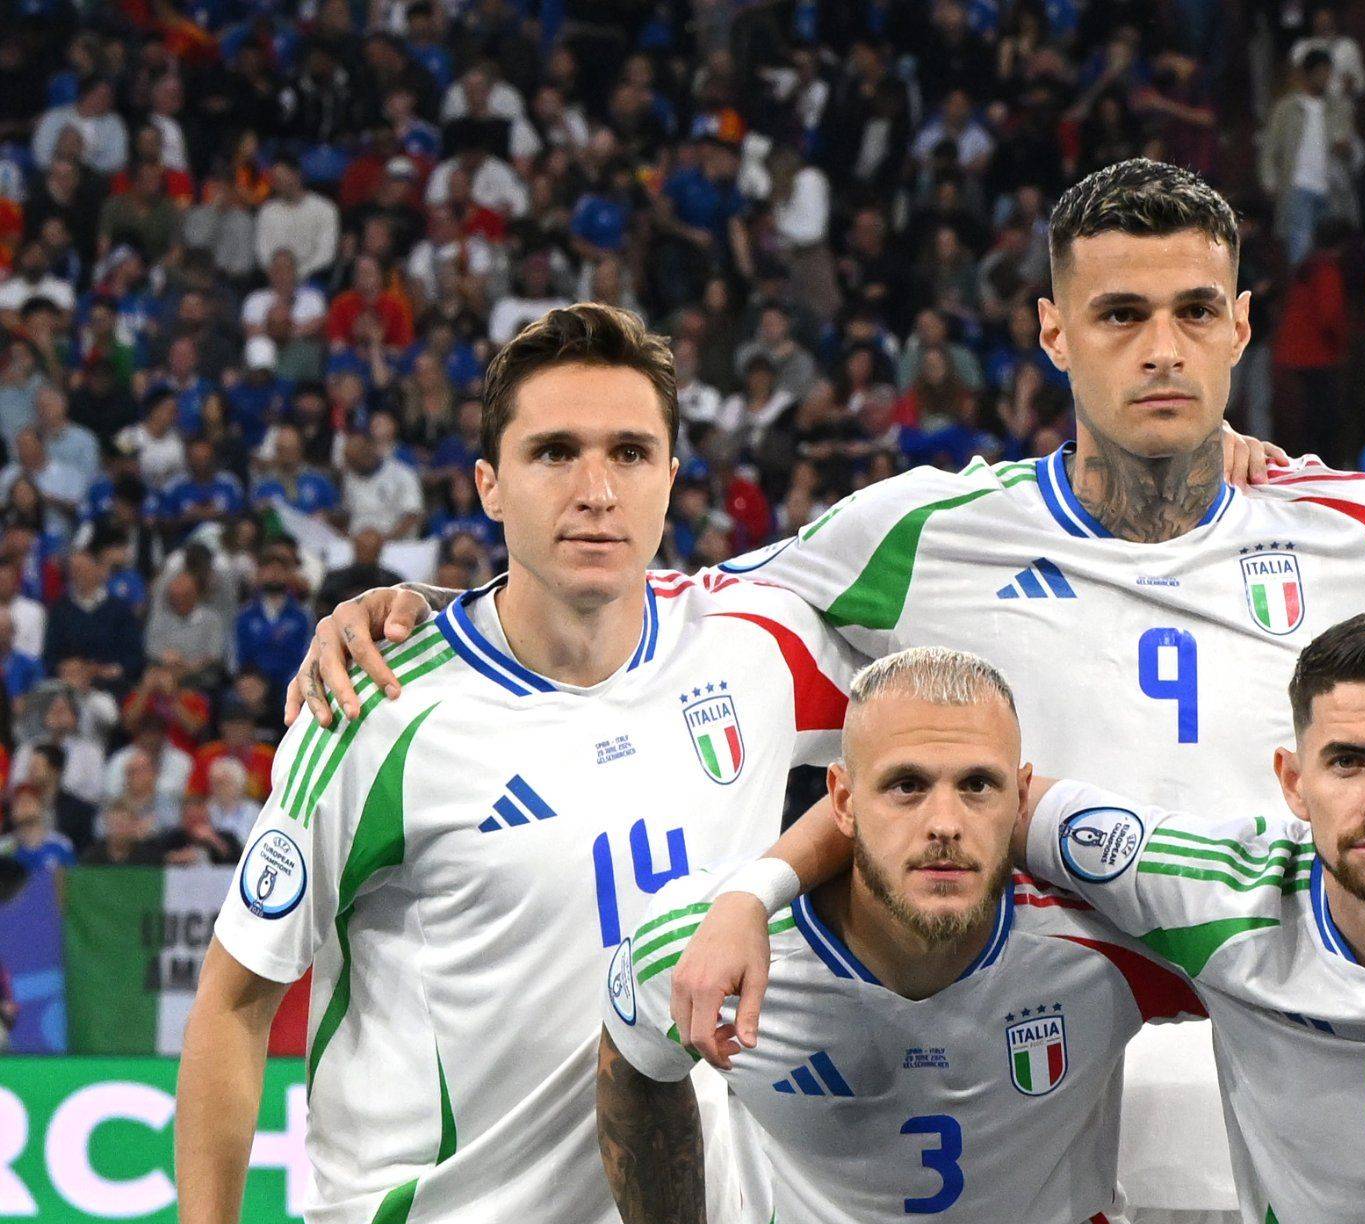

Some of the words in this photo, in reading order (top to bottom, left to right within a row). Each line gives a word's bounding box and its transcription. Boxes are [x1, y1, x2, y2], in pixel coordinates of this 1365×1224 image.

[1246, 559, 1293, 575] ITALIA
[1138, 628, 1199, 744] 9
[689, 703, 731, 727] ITALIA
[260, 851, 292, 876] CHAMPIONS
[263, 842, 295, 868] EUROPEAN
[593, 818, 689, 948] 14
[1011, 1021, 1060, 1044] ITALIA
[900, 1114, 963, 1213] 3
